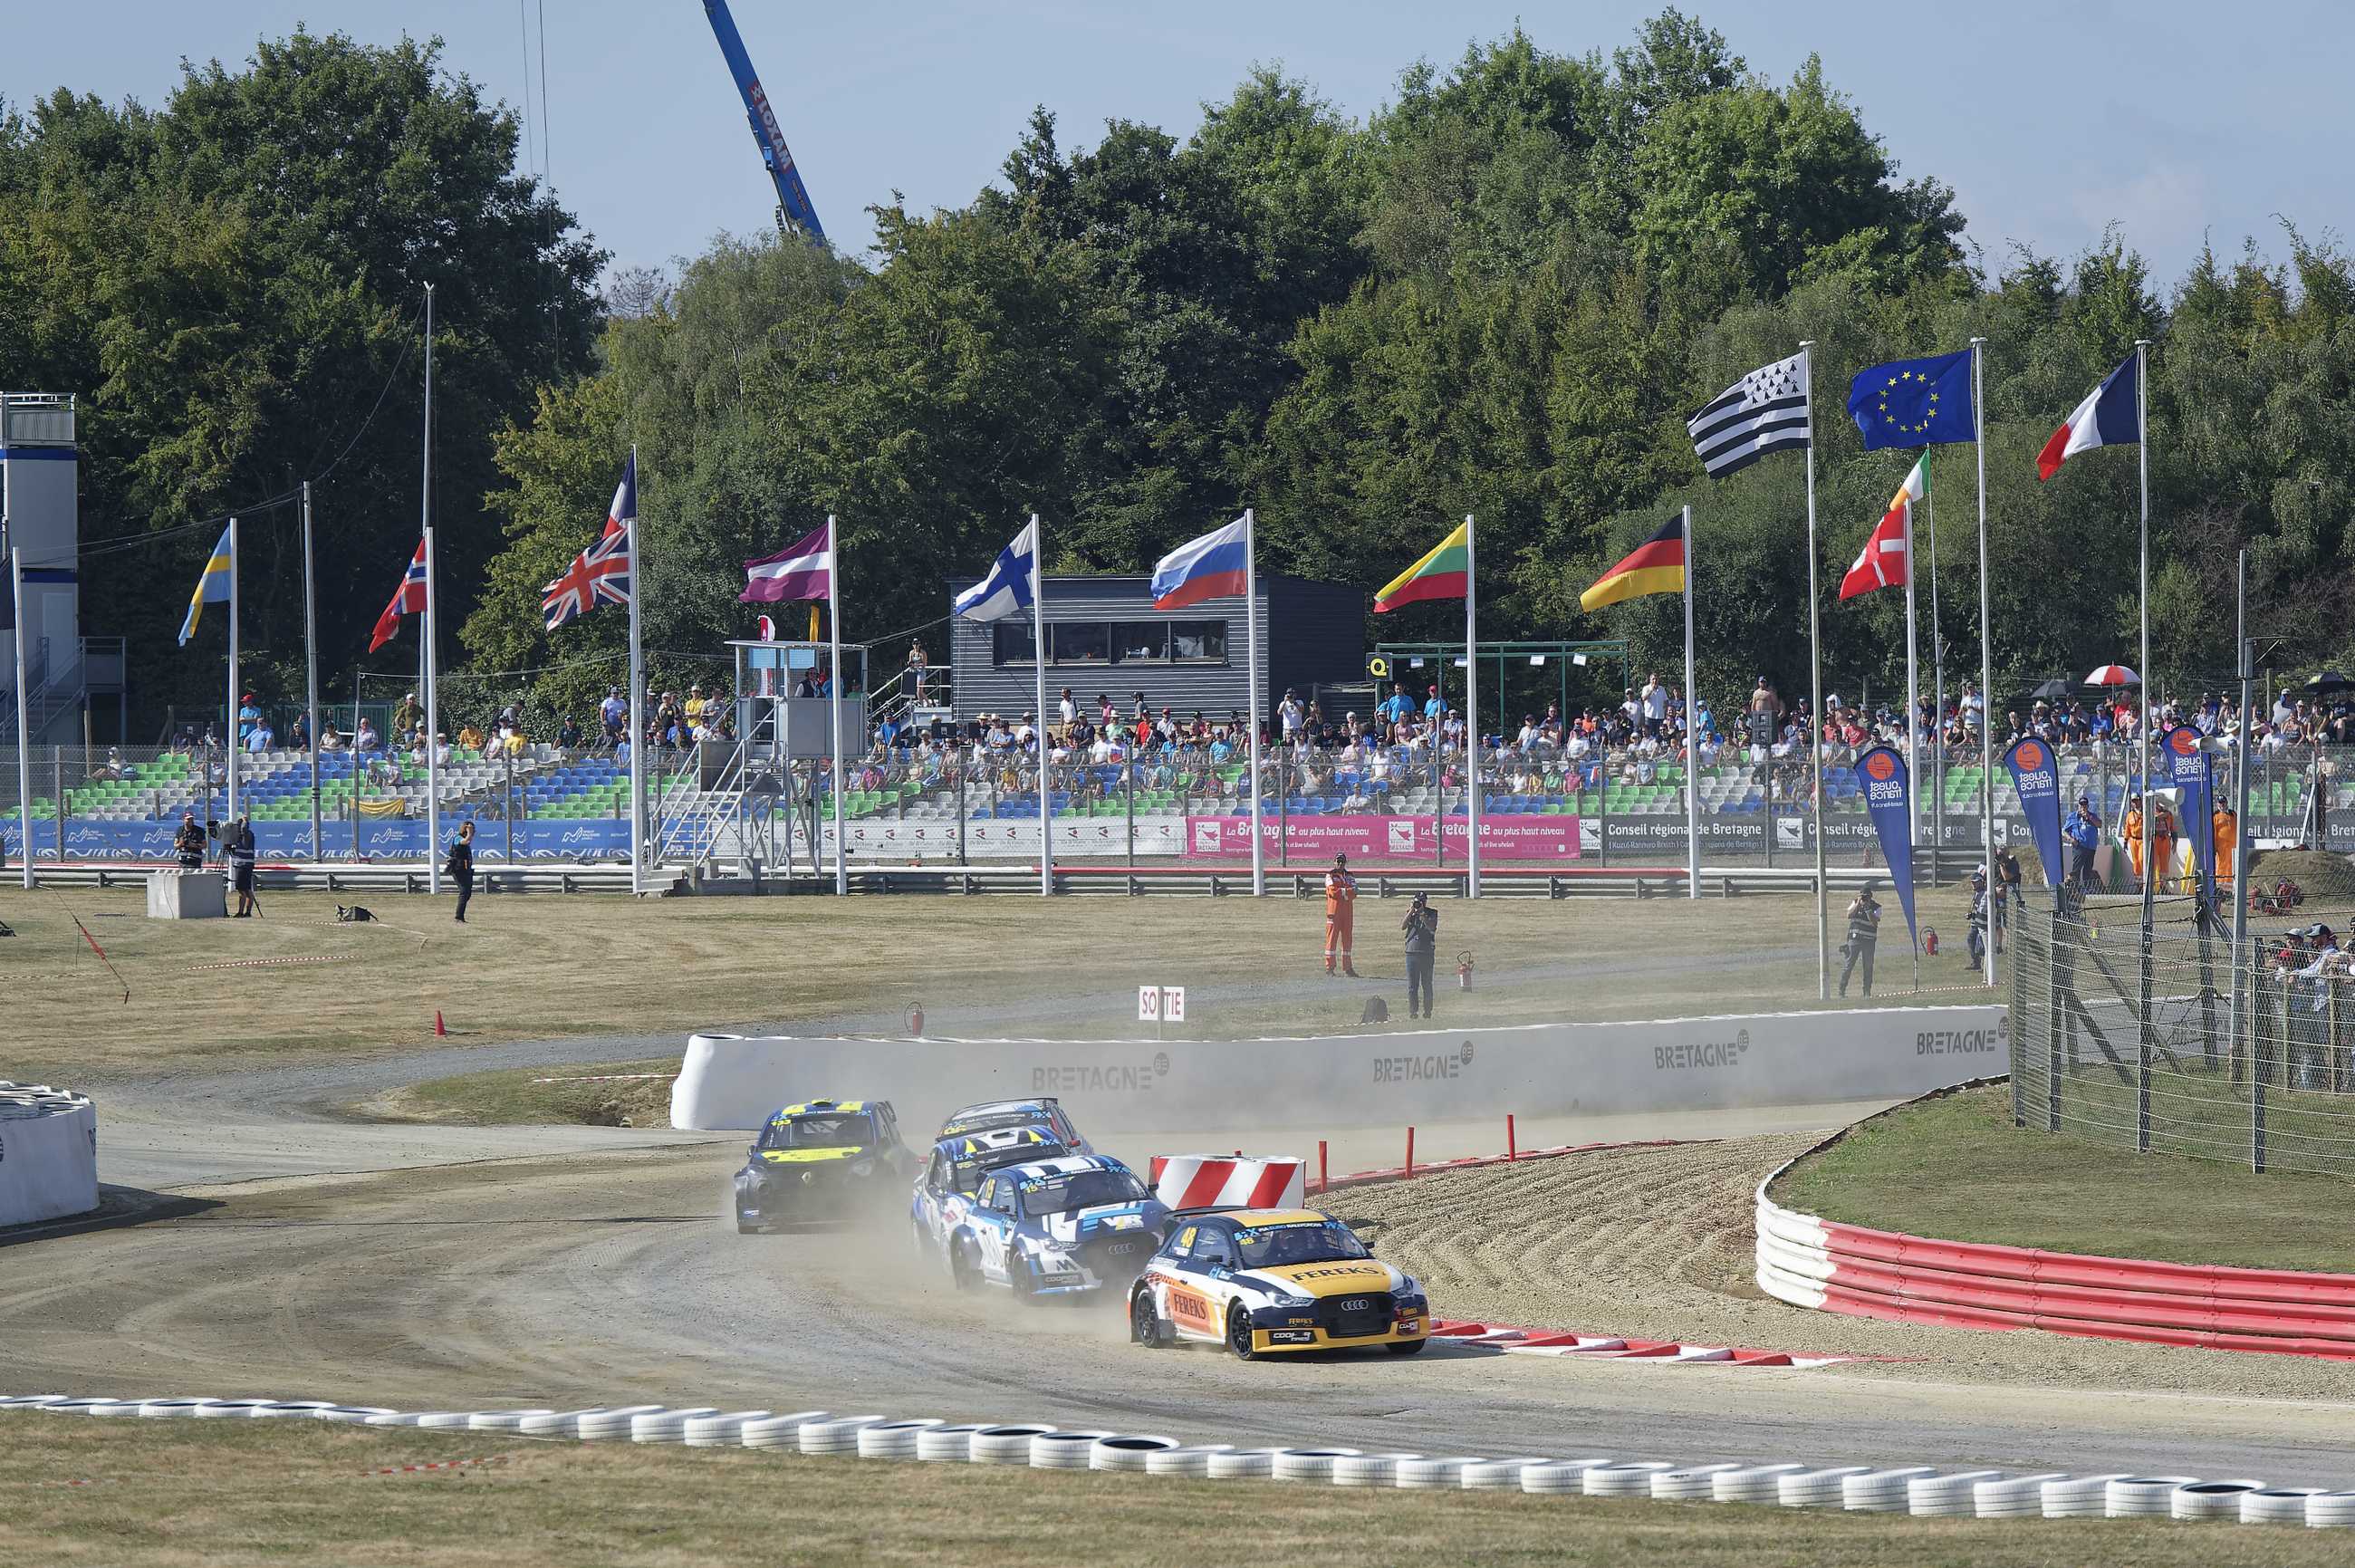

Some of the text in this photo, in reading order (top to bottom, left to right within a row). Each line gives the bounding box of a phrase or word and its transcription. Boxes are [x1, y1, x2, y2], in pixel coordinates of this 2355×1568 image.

[756, 100, 793, 170] LOXAM
[1226, 828, 1235, 836] La
[1310, 827, 1325, 838] plus
[1326, 828, 1343, 836] haut
[1345, 827, 1369, 836] niveau
[1420, 828, 1430, 836] La
[1504, 827, 1520, 838] plus
[1521, 827, 1538, 836] haut
[1540, 827, 1565, 836] niveau
[1609, 823, 1648, 836] Conseil
[1650, 823, 1689, 838] régiona
[1713, 822, 1762, 838] Bretagne
[1142, 992, 1181, 1015] SOTIE
[1917, 1029, 1996, 1055] BRETAGNE
[1373, 1055, 1459, 1082] BRETAGNE
[1654, 1043, 1738, 1069] BRETAGNE
[1032, 1066, 1153, 1092] BRETAGNE
[1292, 1266, 1379, 1282] FEREKS
[1173, 1294, 1206, 1320] FEREKS
